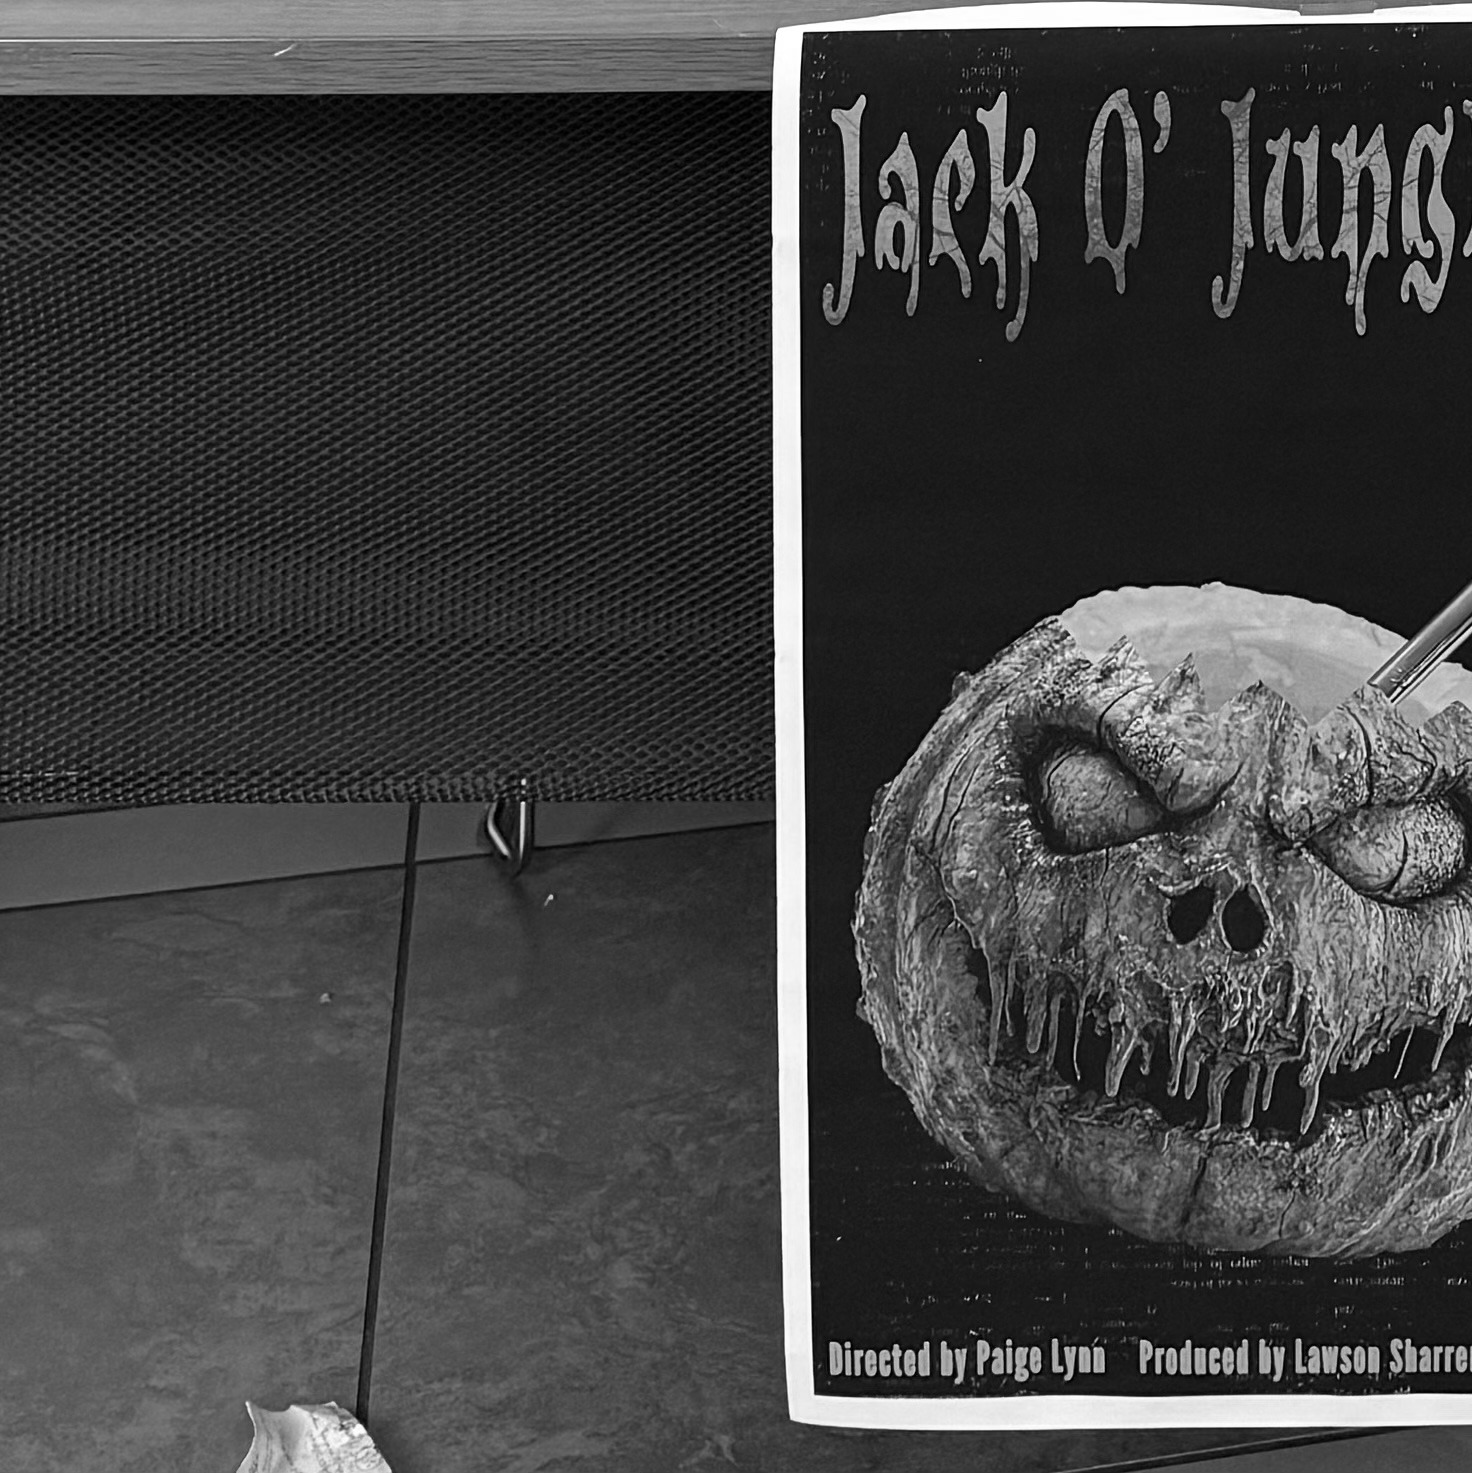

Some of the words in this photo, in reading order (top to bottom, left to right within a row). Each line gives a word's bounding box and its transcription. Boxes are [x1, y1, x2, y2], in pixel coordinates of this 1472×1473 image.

[823, 90, 1038, 343] Jack
[1083, 87, 1173, 295] O'
[828, 1341, 931, 1378] Directed
[939, 1340, 967, 1385] by
[976, 1339, 1043, 1383] Paige
[1050, 1338, 1107, 1382] Lynn
[1138, 1338, 1249, 1377] Produced
[1258, 1339, 1286, 1384] by
[1293, 1339, 1380, 1375] Lawson
